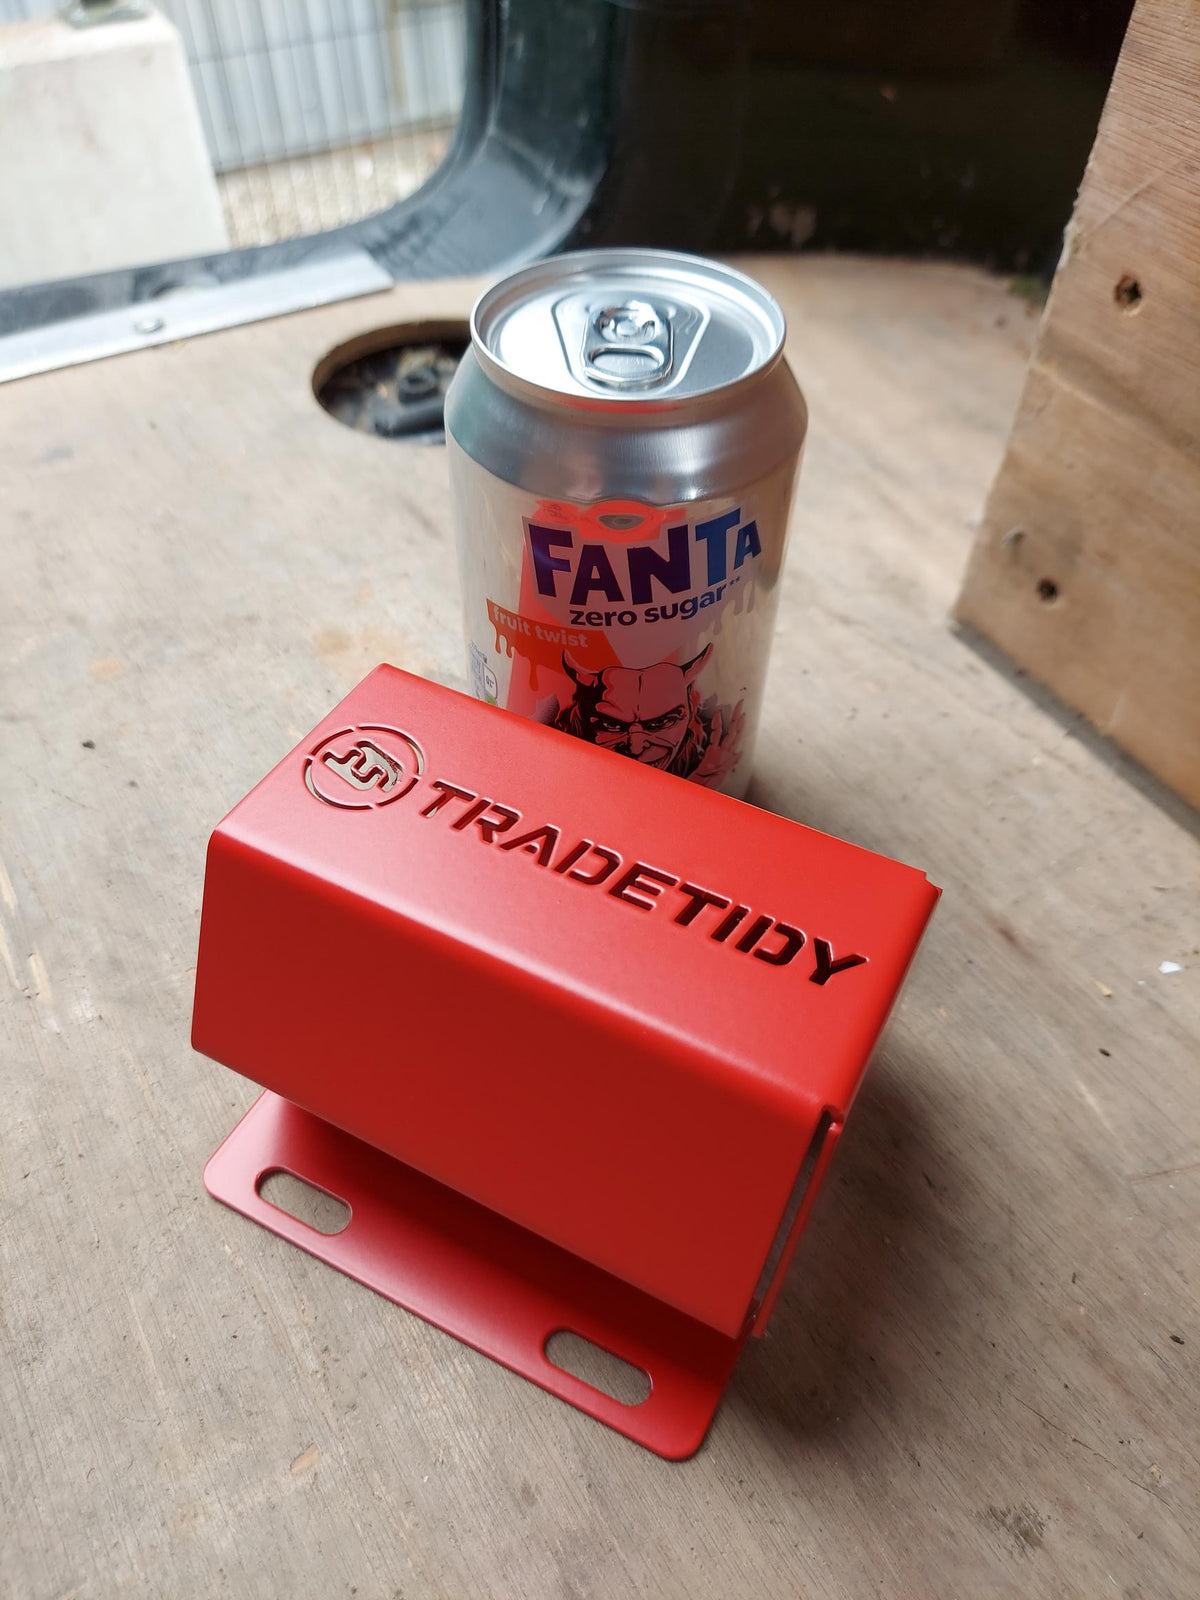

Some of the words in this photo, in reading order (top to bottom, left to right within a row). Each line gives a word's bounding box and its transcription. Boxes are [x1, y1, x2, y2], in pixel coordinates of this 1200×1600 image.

[528, 508, 762, 605] FANTA
[493, 605, 532, 637] fruit
[535, 624, 589, 648] twist
[569, 609, 638, 627] zero
[420, 780, 867, 985] TRADETIDY
